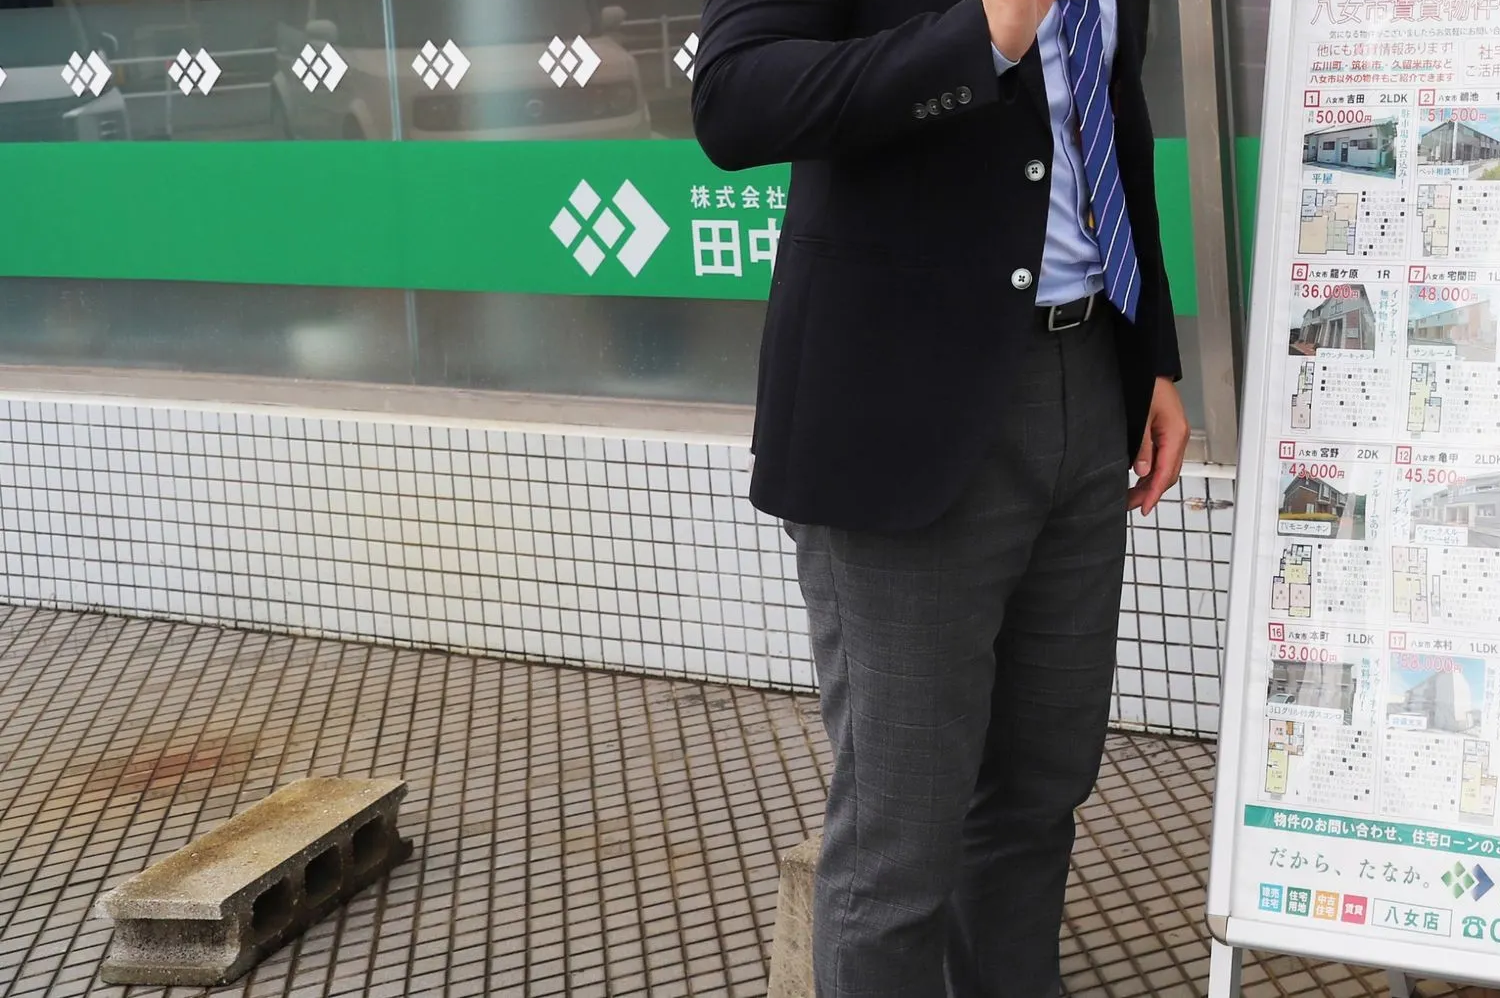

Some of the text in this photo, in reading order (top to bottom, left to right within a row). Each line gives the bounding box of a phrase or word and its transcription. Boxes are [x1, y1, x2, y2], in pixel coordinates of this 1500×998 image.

[1309, 95, 1315, 103] 1
[1380, 94, 1408, 103] 2LDK
[1424, 94, 1430, 102] 2
[1316, 110, 1372, 124] 50,000円
[1312, 173, 1333, 184] 平屋
[690, 185, 787, 209] 株式会社
[691, 218, 782, 277] 田中
[1297, 268, 1303, 276] 6
[1377, 269, 1390, 279] 1R
[1413, 270, 1420, 279] 7
[1301, 284, 1359, 299] 36,000円
[1283, 446, 1291, 455] 11
[1320, 447, 1339, 458] 宮野
[1357, 449, 1379, 459] 2DK
[1399, 451, 1408, 461] 12
[1415, 454, 1435, 462] 八女市
[1438, 452, 1458, 463] 亀甲
[1271, 627, 1281, 638] 16
[1309, 630, 1330, 642] 本町
[1346, 633, 1374, 644] 1LDK
[1278, 644, 1337, 662] 53,000円
[1433, 639, 1453, 650] 本村
[1470, 642, 1498, 654] 1LDK
[1289, 890, 1307, 902] 住宅
[1288, 901, 1306, 913] 用地
[1345, 903, 1363, 916] 賃貸
[1384, 906, 1441, 931] 八女店
